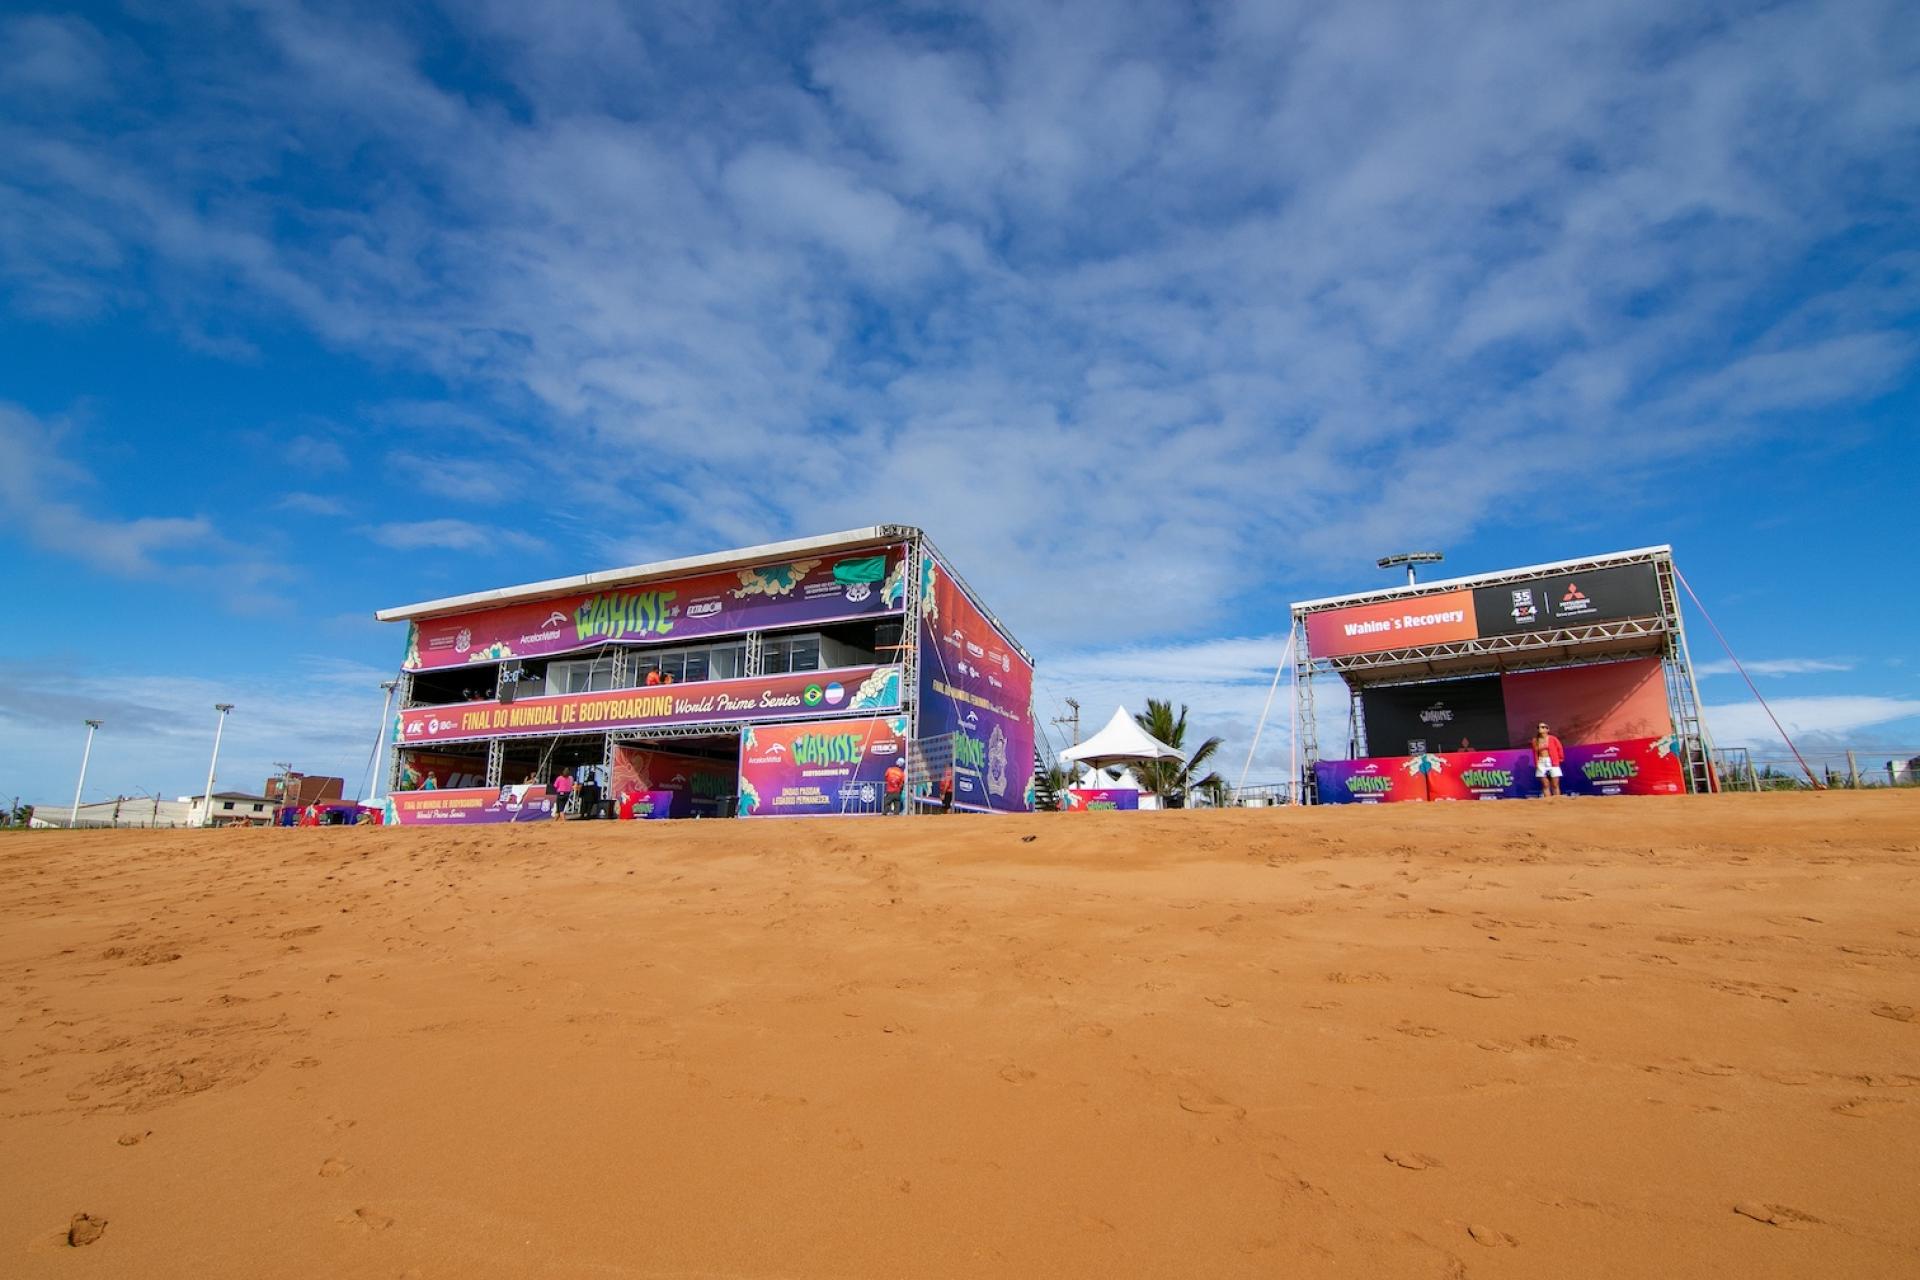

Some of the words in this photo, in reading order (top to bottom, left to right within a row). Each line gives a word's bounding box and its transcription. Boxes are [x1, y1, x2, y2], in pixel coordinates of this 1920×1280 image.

[573, 590, 677, 641] WAHINE
[1403, 609, 1464, 628] Recovery
[462, 711, 491, 731] FINAL
[493, 709, 508, 728] DO
[510, 705, 558, 727] MUNDIAL
[561, 703, 576, 723] DE
[579, 696, 673, 722] BODYBOARDING
[675, 696, 715, 715] World
[716, 693, 757, 712] Prime
[759, 690, 801, 708] Series
[791, 732, 863, 767] WAHINE
[1460, 769, 1513, 788] WAHINE
[1582, 759, 1636, 780] WAHINE
[1345, 776, 1392, 792] WAHINE
